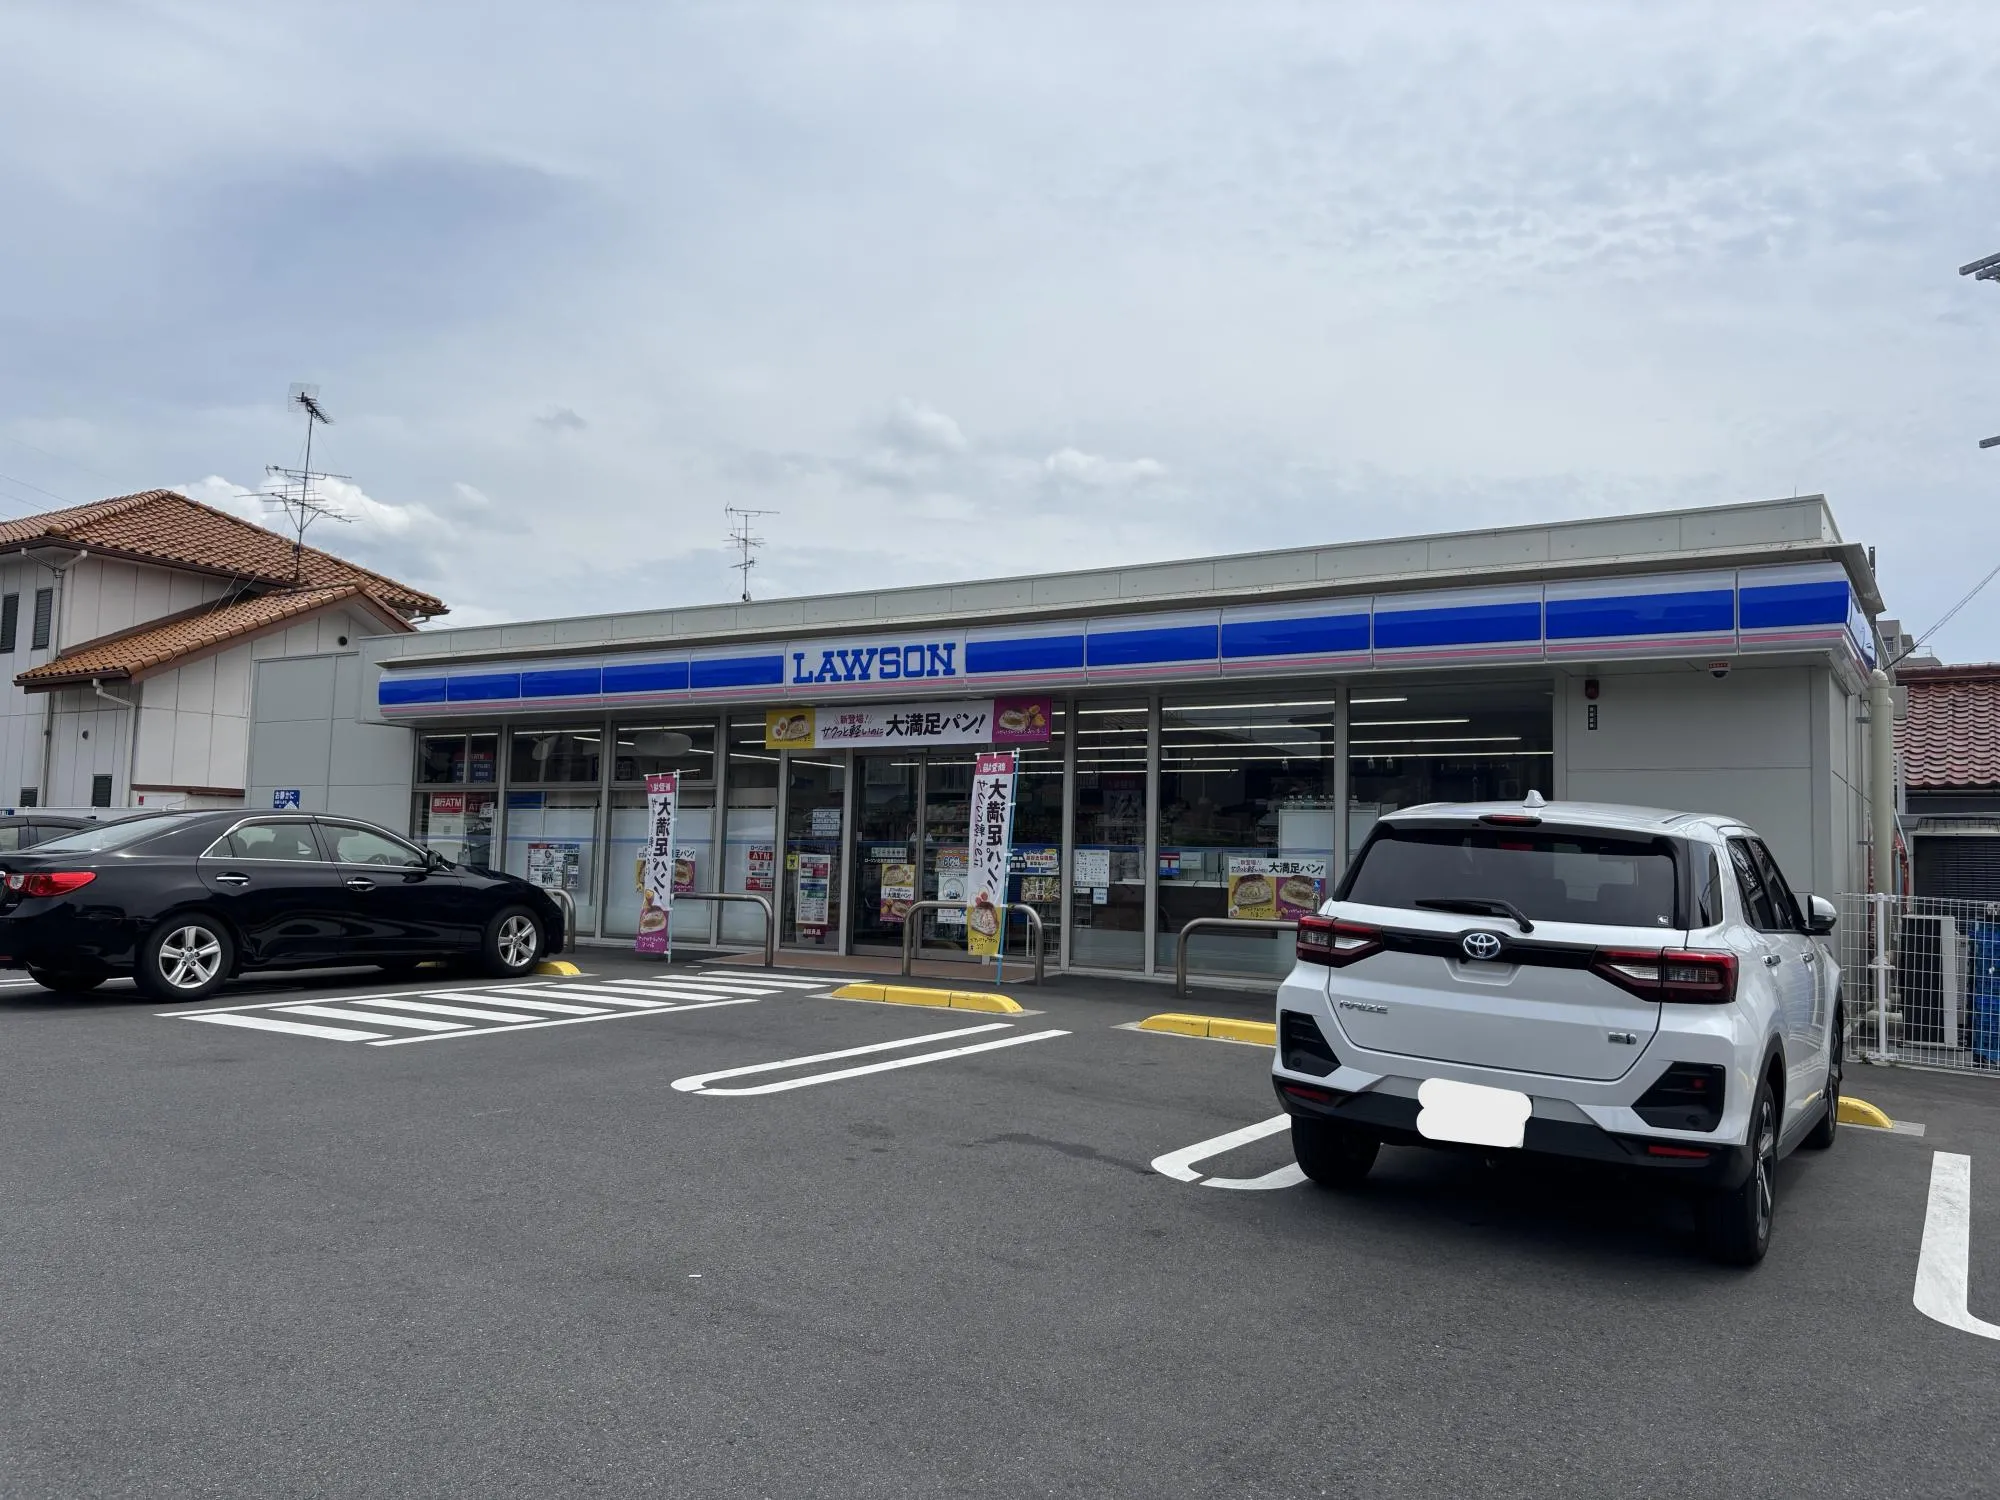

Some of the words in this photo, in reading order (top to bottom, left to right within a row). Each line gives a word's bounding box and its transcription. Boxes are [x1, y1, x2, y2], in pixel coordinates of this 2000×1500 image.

[793, 643, 956, 684] LAWSON
[885, 712, 986, 737] 大満足パン!
[752, 852, 770, 860] ATM
[1268, 861, 1324, 875] 大満足パン!
